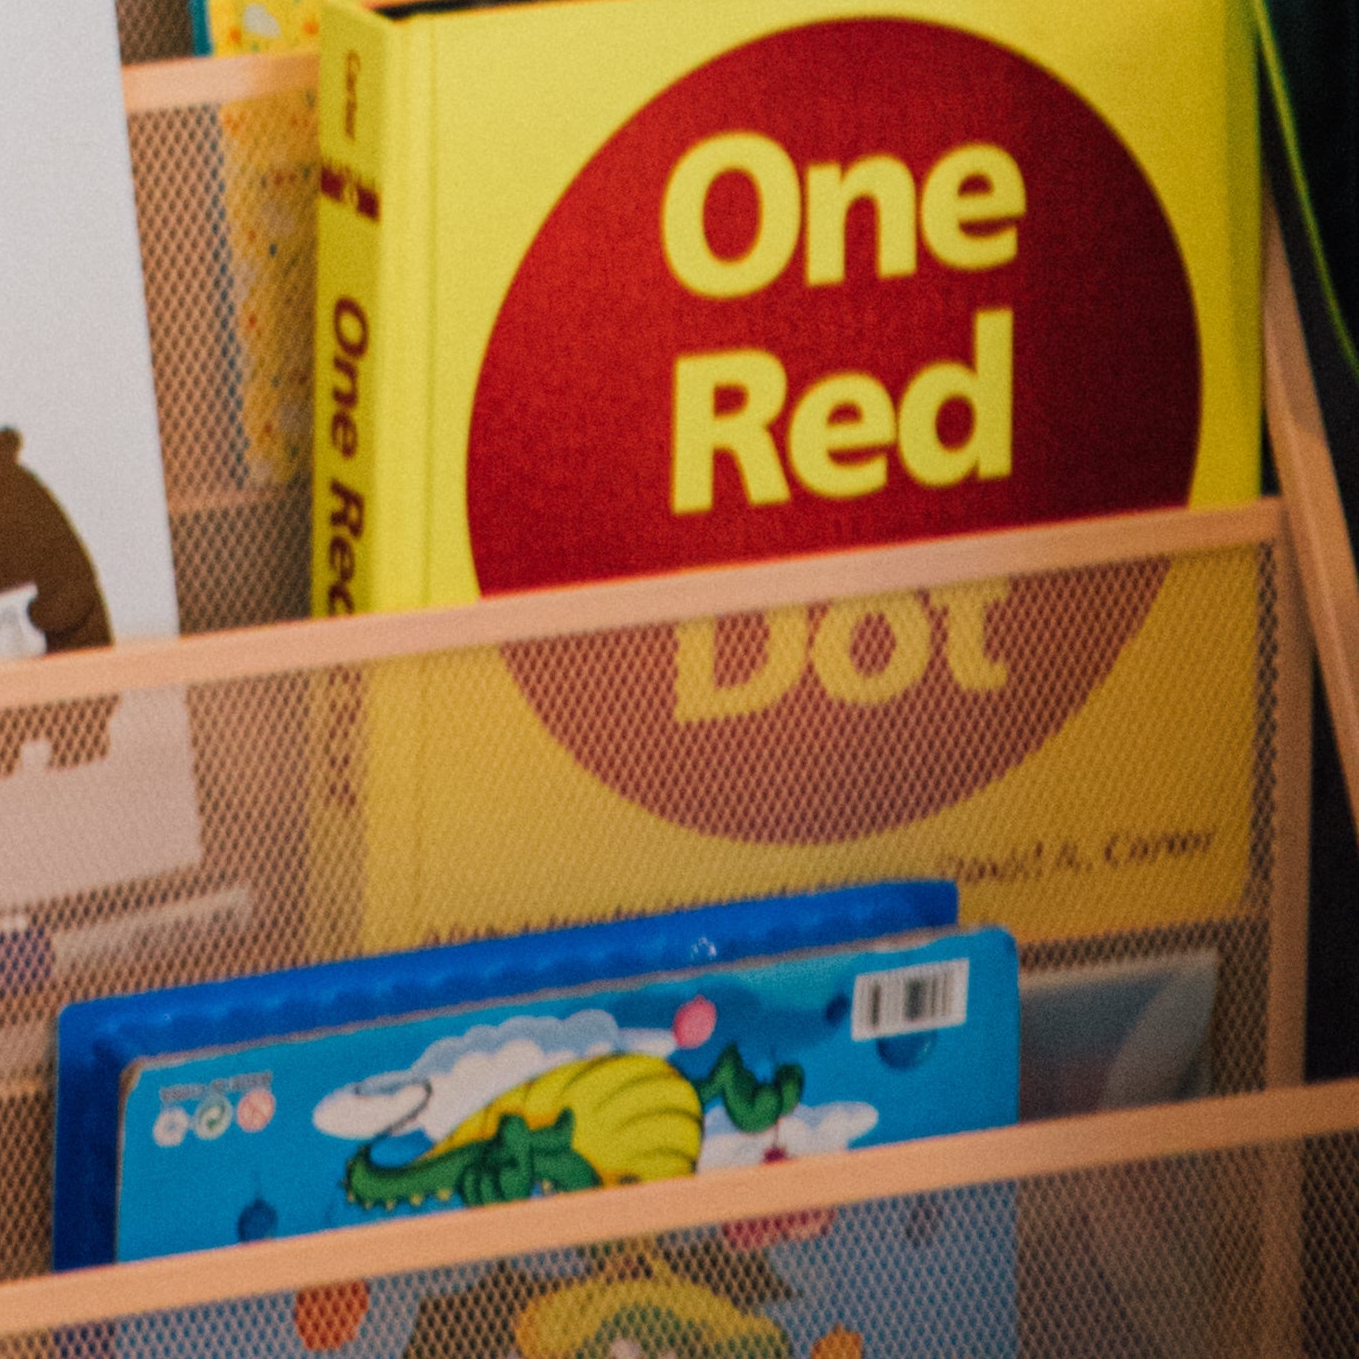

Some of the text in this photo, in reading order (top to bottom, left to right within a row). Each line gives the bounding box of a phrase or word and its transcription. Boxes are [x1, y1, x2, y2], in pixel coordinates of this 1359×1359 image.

[657, 129, 1027, 302] One
[328, 293, 372, 460] One
[669, 308, 1017, 517] Red
[670, 586, 1009, 726] Dot
